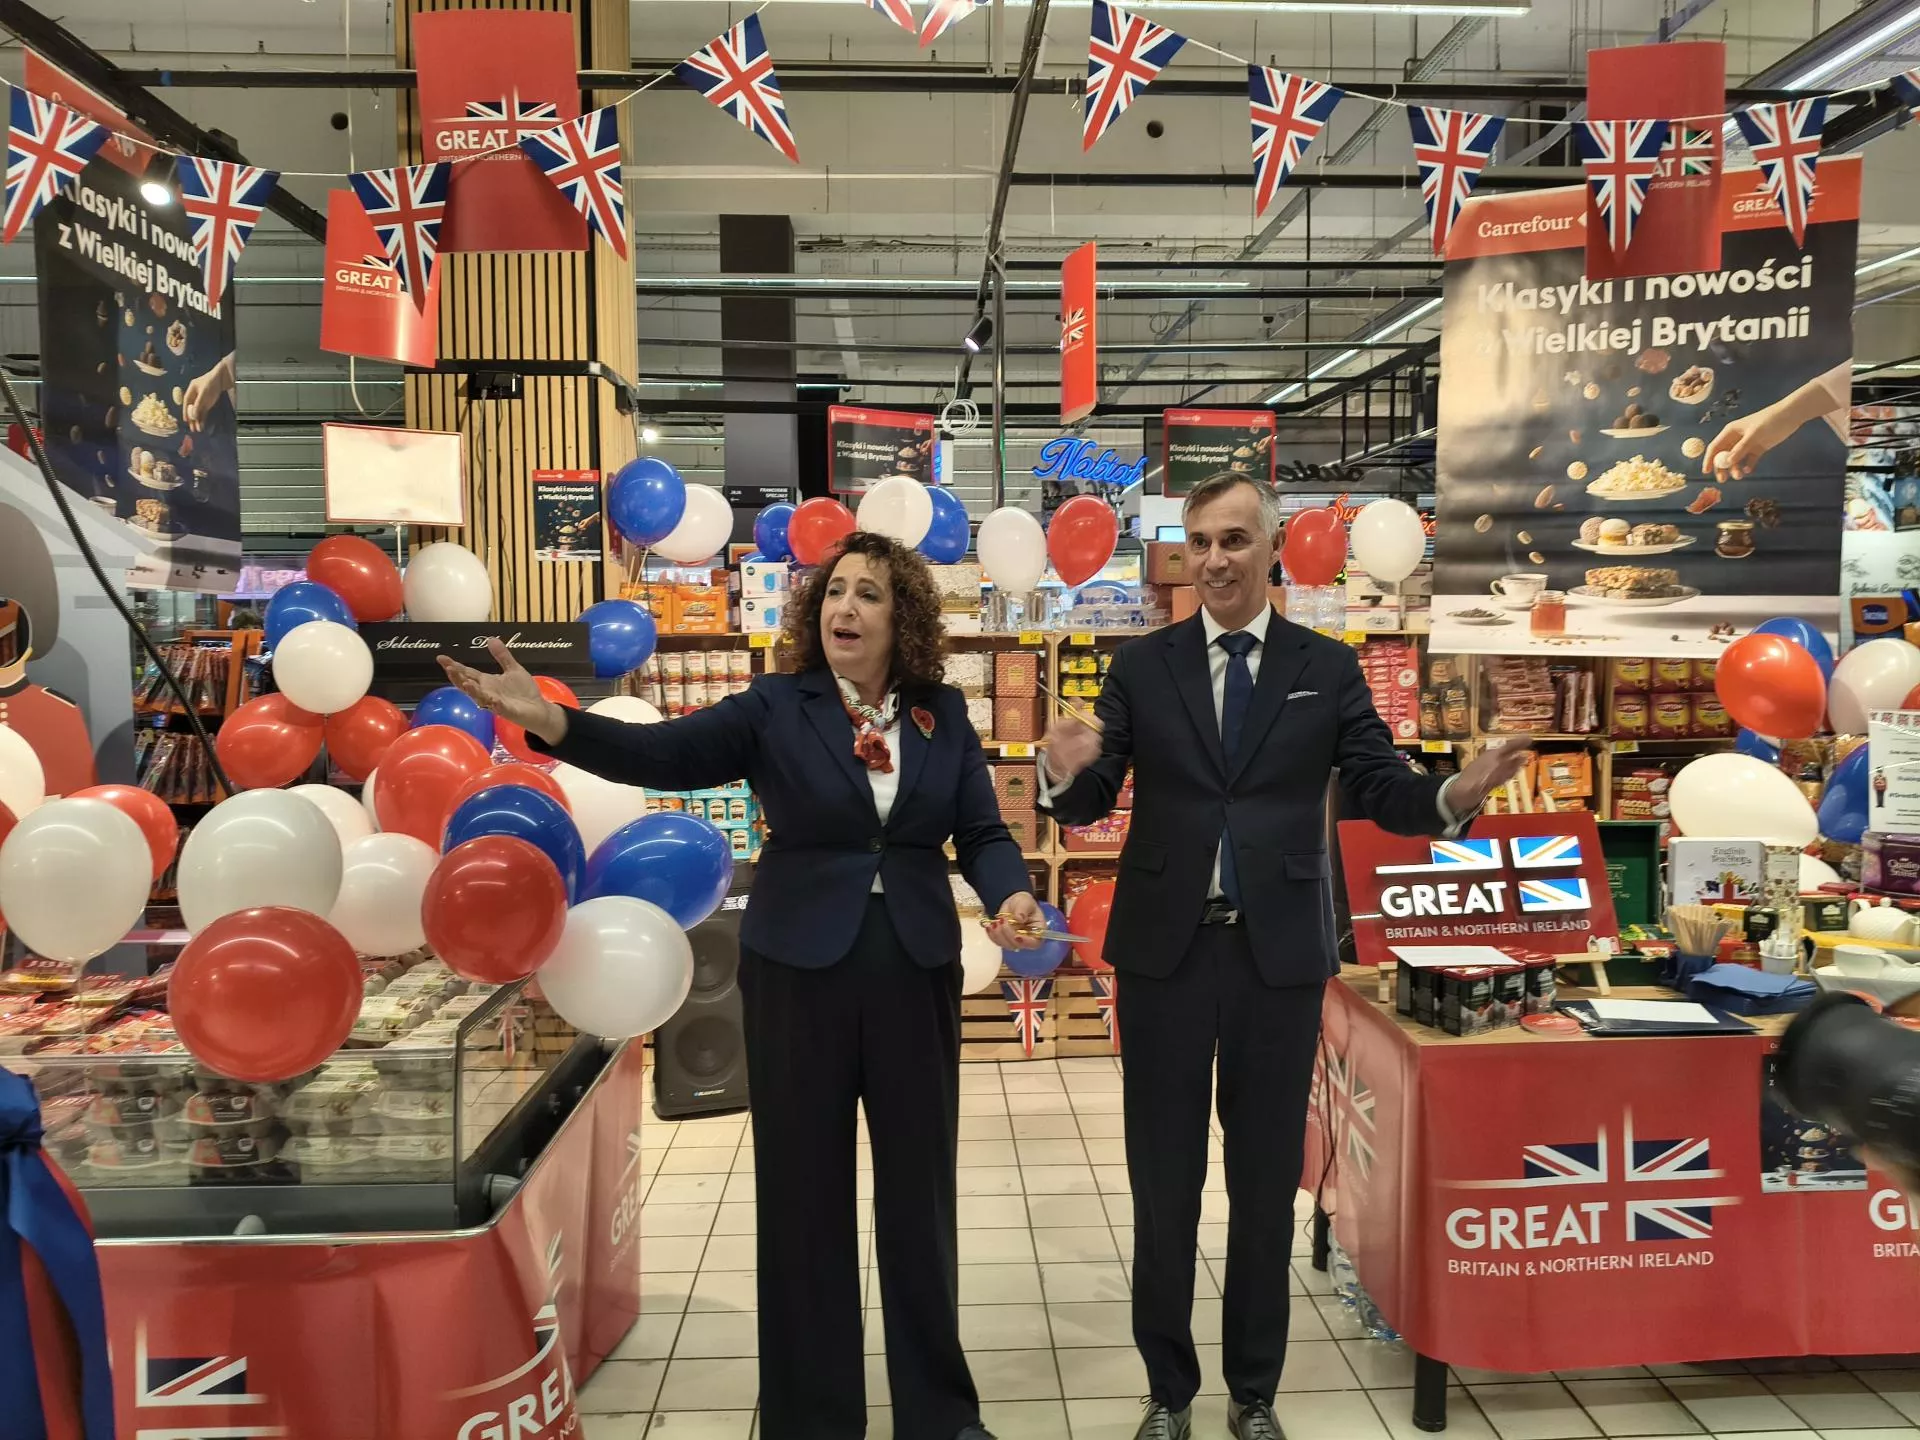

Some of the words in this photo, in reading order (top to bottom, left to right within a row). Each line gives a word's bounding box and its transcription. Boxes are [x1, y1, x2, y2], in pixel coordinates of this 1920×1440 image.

[436, 128, 508, 151] GREAT
[1652, 158, 1676, 178] AT
[1733, 198, 1779, 213] GREA
[1478, 213, 1574, 240] Carrefour
[141, 210, 148, 240] i
[152, 224, 200, 268] nowo
[58, 222, 73, 249] z
[74, 222, 153, 293] Wielkiej
[335, 269, 393, 290] GREAT
[1478, 277, 1613, 316] Klasyki
[1645, 254, 1813, 302] nowości
[1503, 317, 1642, 357] Wielkiej
[1652, 306, 1811, 352] Brytanii
[836, 440, 863, 451] Klasyki
[1169, 443, 1196, 453] Klasyki
[376, 636, 442, 651] Selection
[505, 631, 573, 650] koneserów
[1380, 881, 1507, 918] GREAT
[1385, 926, 1438, 939] BRITAIN
[1441, 925, 1451, 937] &
[1454, 920, 1530, 936] NORTHERN
[1532, 919, 1592, 932] IRELAND
[611, 1178, 640, 1246] GRE
[1445, 1201, 1609, 1250] GREAT
[1873, 1242, 1920, 1258] BRITA
[1447, 1259, 1520, 1277] BRITAIN
[1525, 1262, 1537, 1276] &
[1540, 1254, 1633, 1274] NORTHERN
[1639, 1251, 1714, 1269] IRELAND
